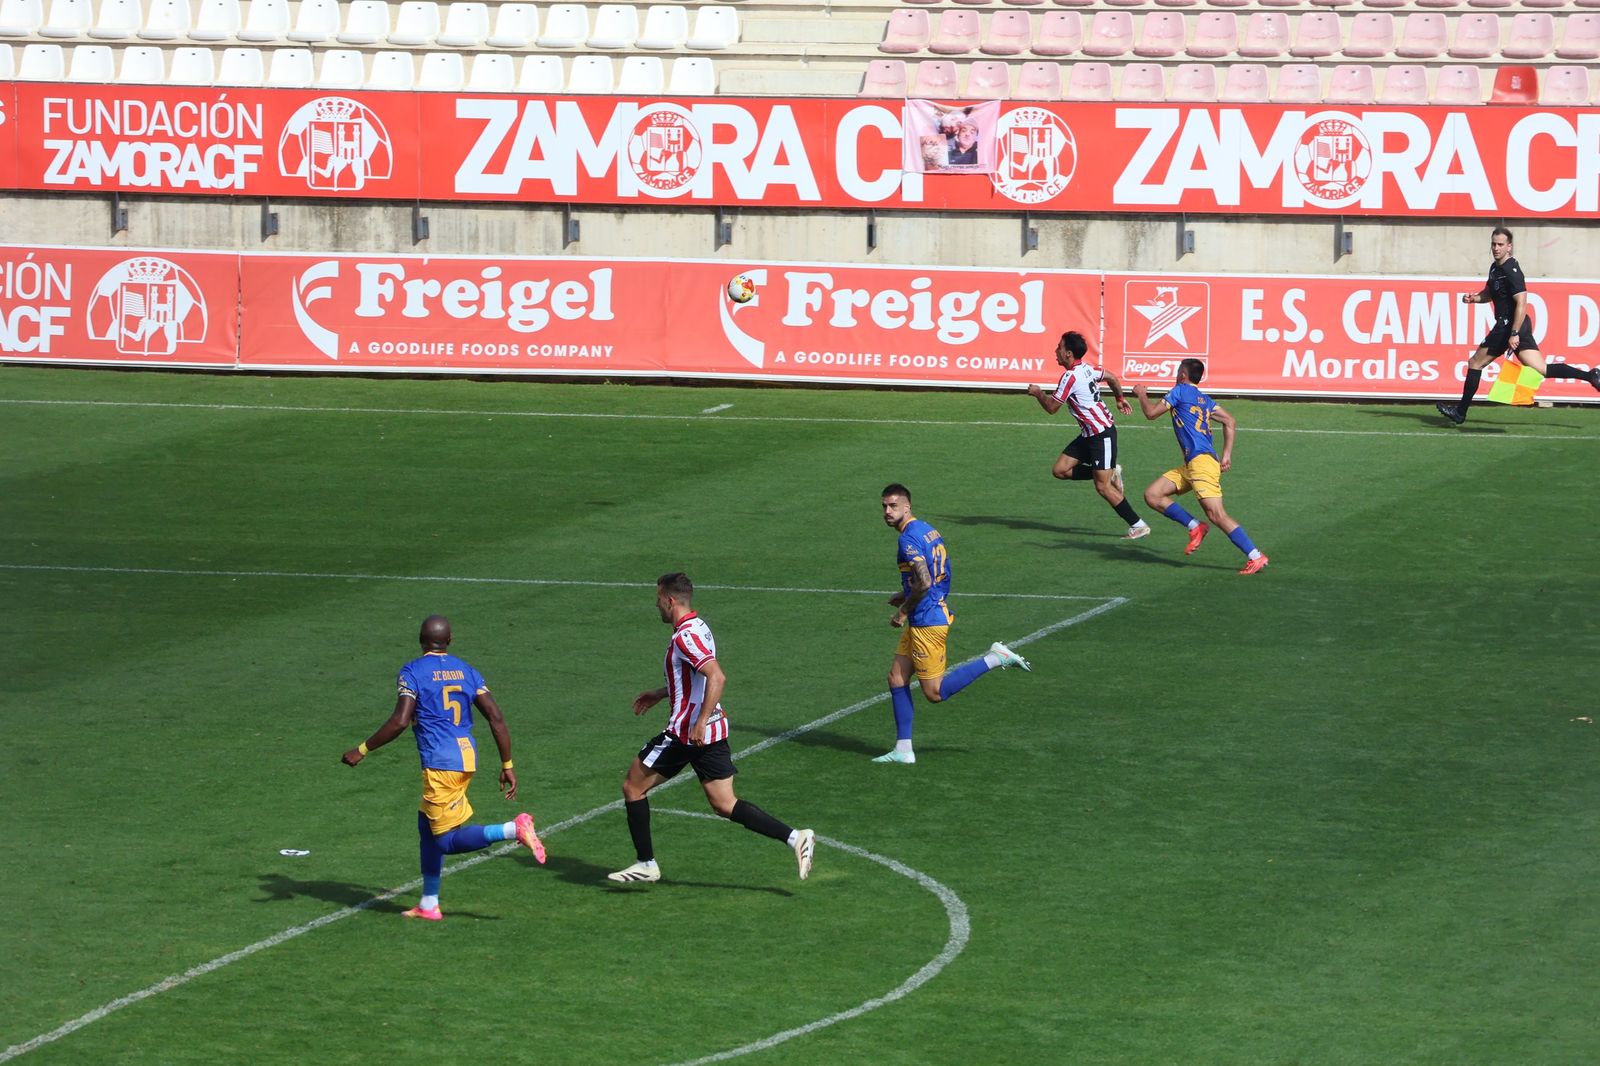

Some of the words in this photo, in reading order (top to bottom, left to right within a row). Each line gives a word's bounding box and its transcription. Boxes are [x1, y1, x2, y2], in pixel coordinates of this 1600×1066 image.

[43, 93, 263, 137] FUNDACIÓN
[43, 139, 264, 190] ZAMORACF
[455, 98, 822, 202] ZAMORA
[836, 104, 925, 202] C
[1112, 107, 1498, 211] ZAMORA
[0, 252, 72, 301] IÓN
[354, 262, 615, 334] Freigel
[781, 271, 1047, 345] Freigel
[1241, 288, 1325, 344] E.S.
[349, 341, 361, 354] A
[368, 341, 454, 356] GOODLIFE
[461, 343, 520, 357] FOODS
[527, 344, 614, 358] COMPANY
[774, 350, 787, 363] A
[794, 350, 882, 367] GOODLIFE
[889, 354, 949, 369] FOODS
[956, 356, 1045, 371] COMPANY
[1281, 348, 1440, 382] Morales
[442, 685, 463, 726] 5
